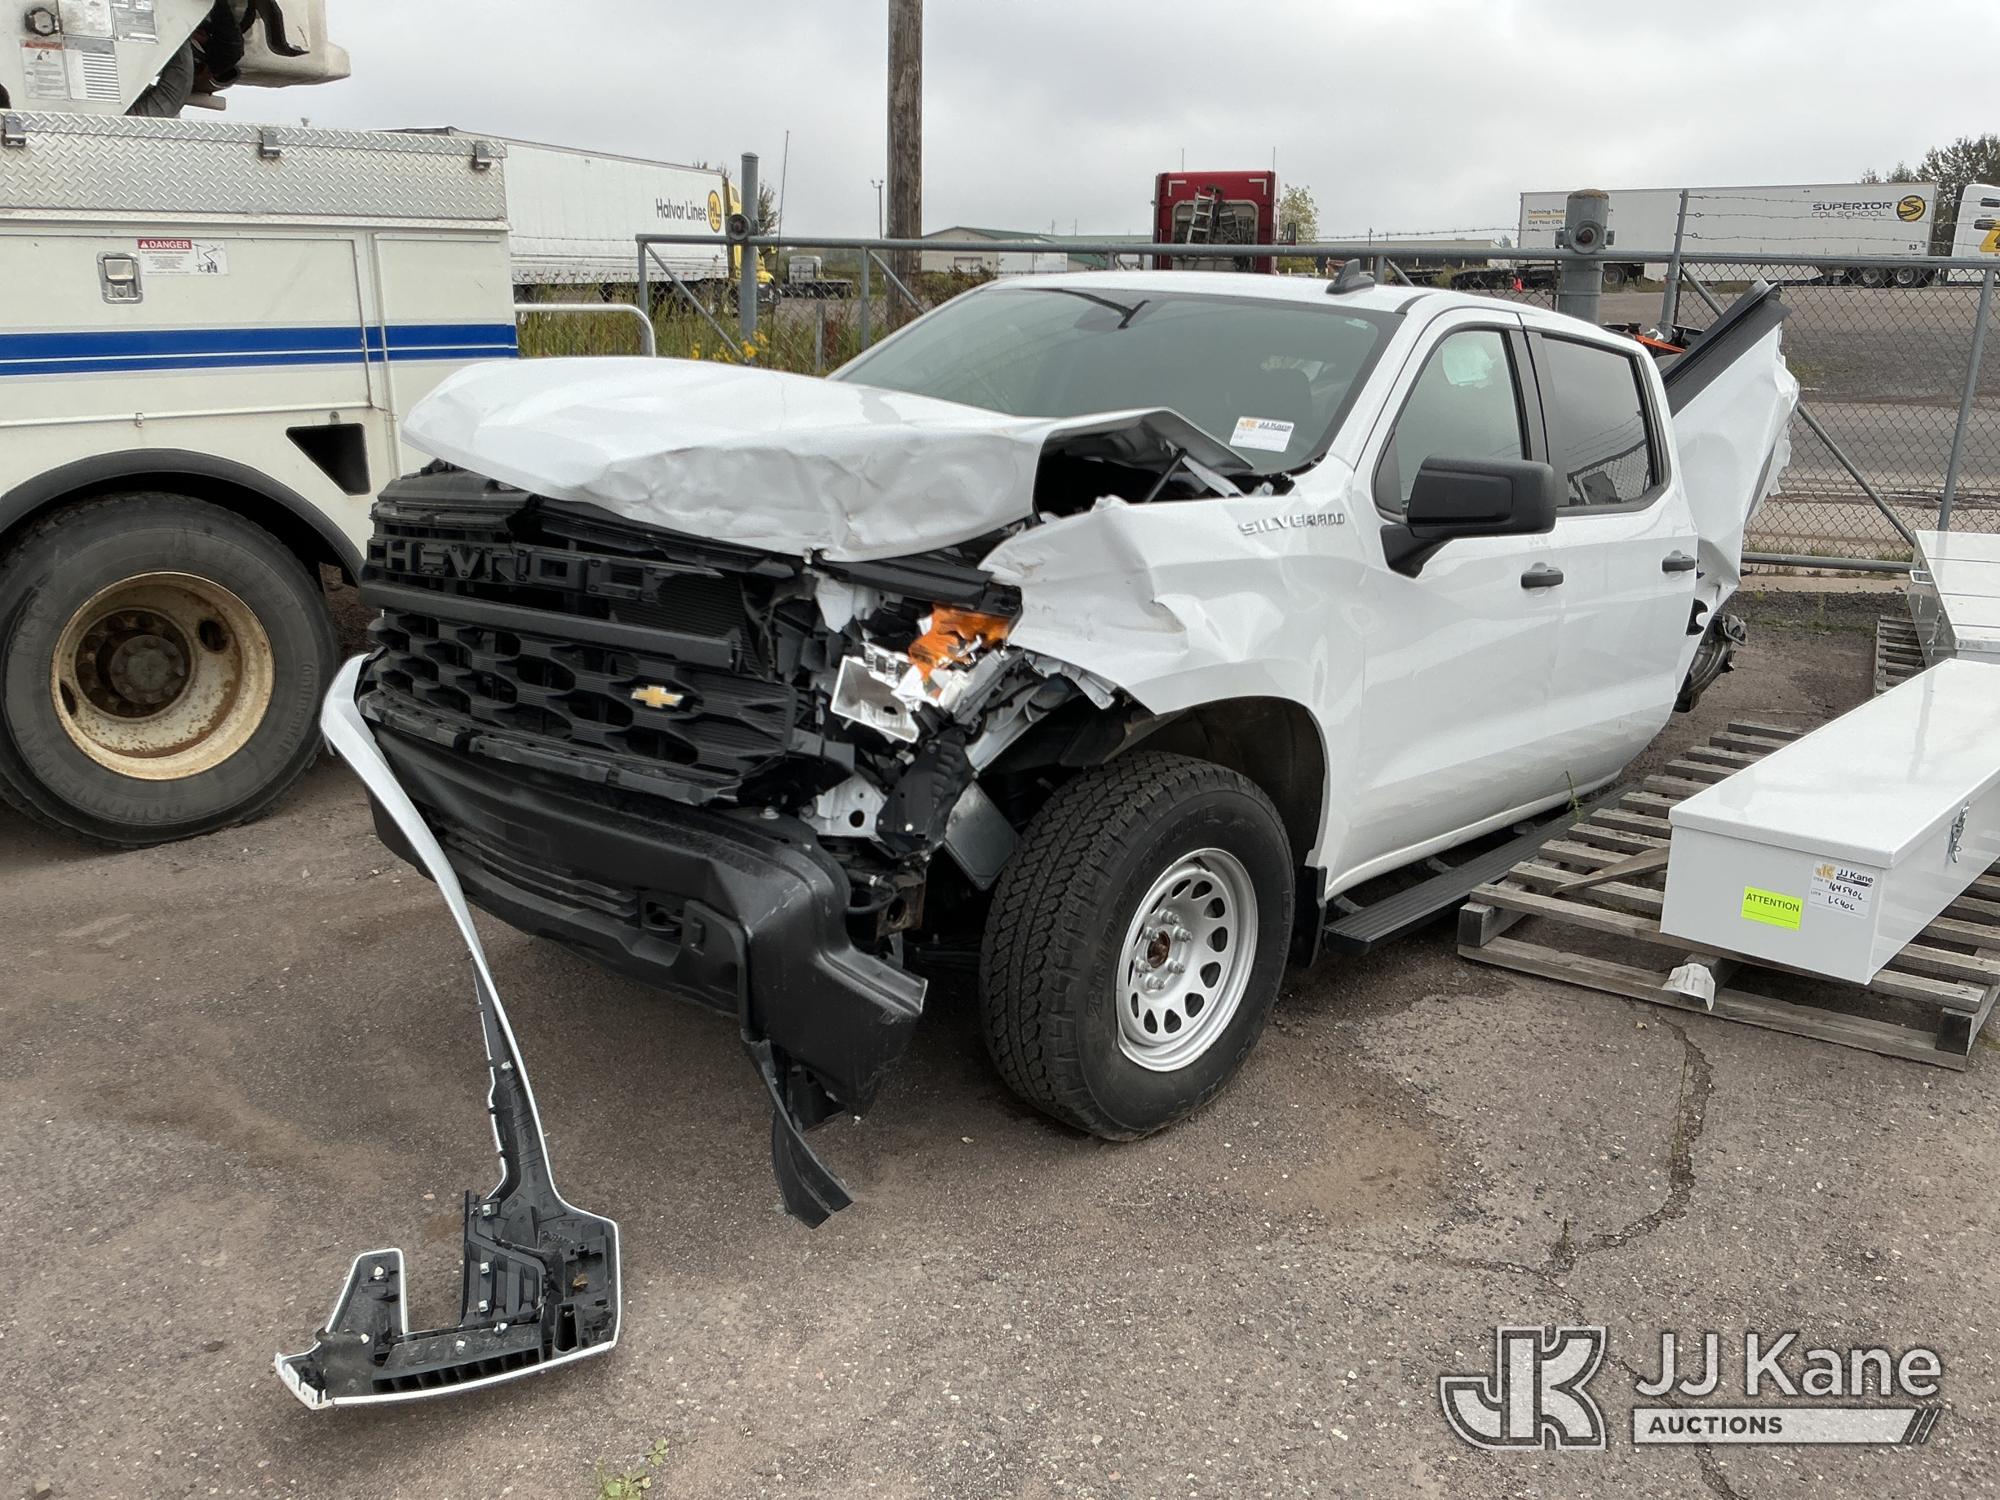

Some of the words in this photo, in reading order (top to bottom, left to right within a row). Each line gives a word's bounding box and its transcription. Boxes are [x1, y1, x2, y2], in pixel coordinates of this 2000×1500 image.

[656, 198, 684, 219] Halvor
[685, 200, 707, 221] Lines
[1812, 202, 1892, 211] SUPERIOR
[149, 240, 190, 249] DANGER
[1238, 513, 1345, 536] SILVERADO
[1837, 869, 1848, 877] JJ
[1849, 871, 1874, 884] Kane
[1746, 892, 1800, 913] ATTENTION
